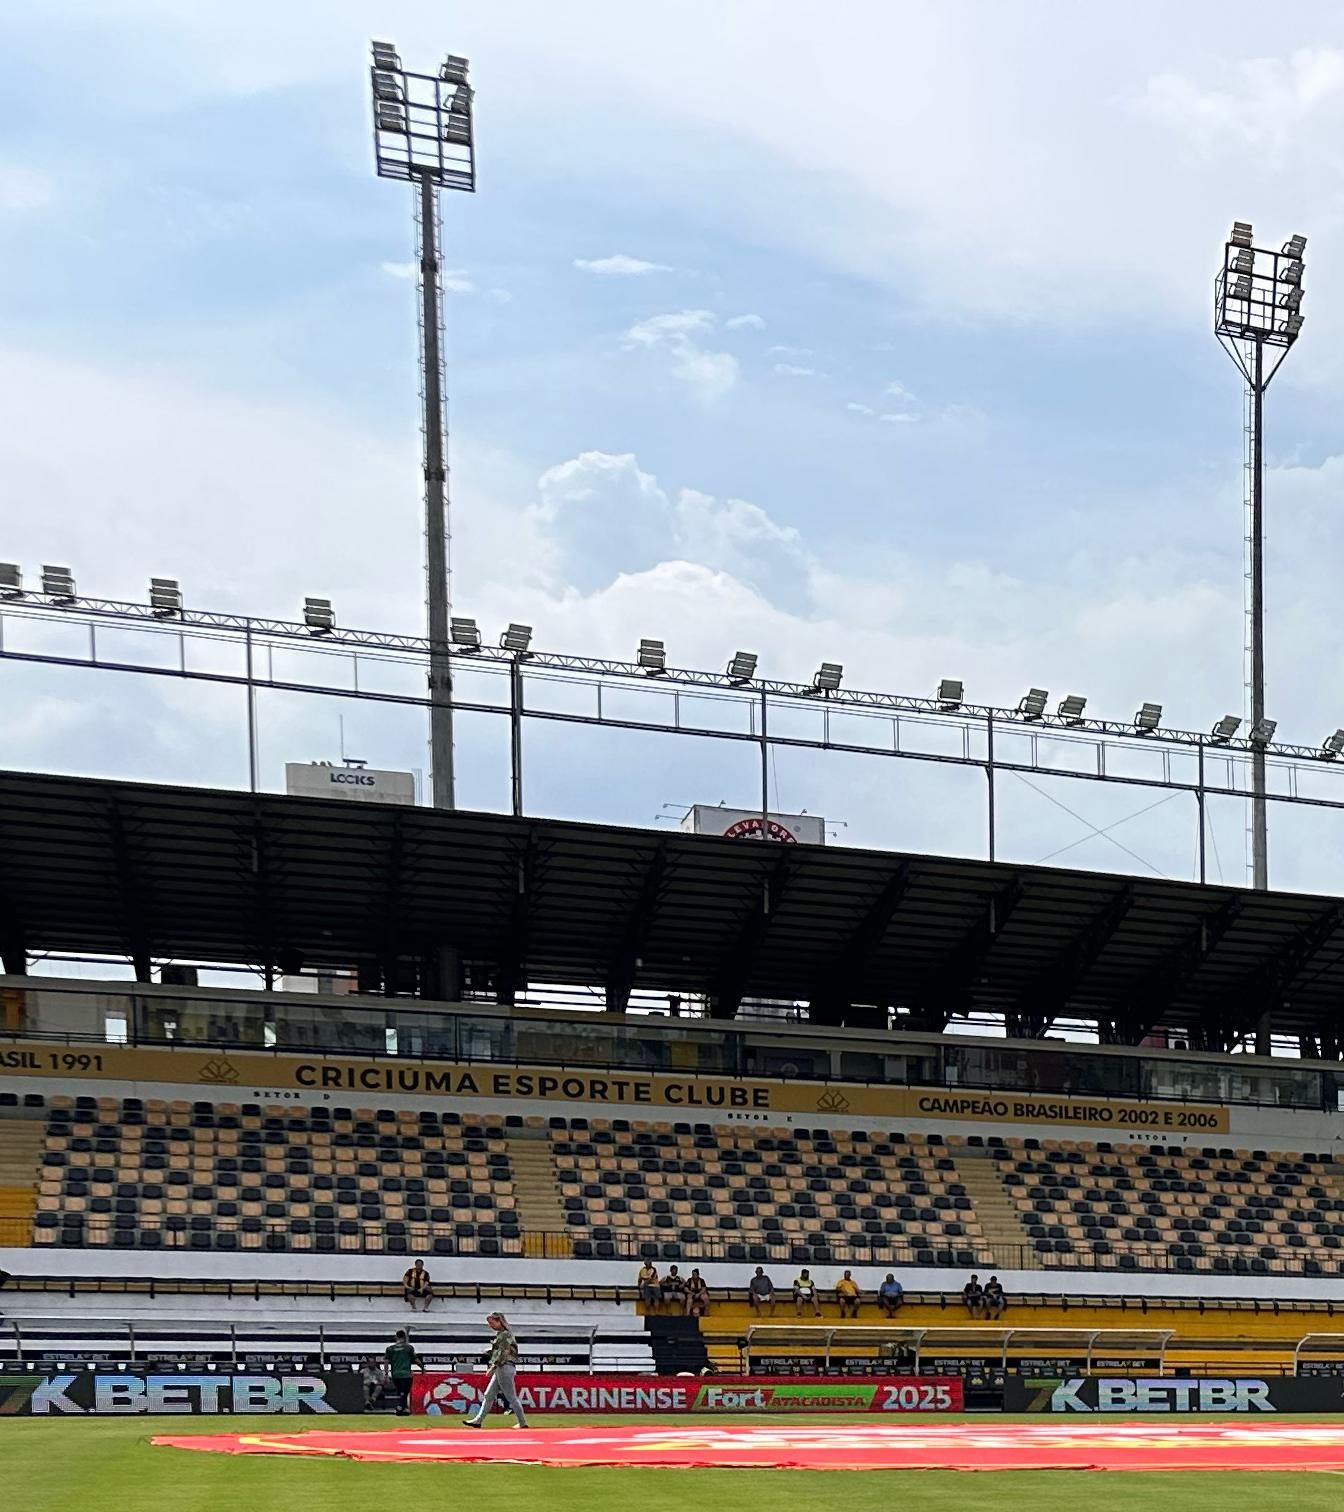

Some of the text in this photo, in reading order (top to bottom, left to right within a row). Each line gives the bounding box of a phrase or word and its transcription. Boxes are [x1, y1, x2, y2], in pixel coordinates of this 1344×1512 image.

[49, 1053, 103, 1071] 1991
[295, 1064, 770, 1108] CRICIÚMA ESPORTE CLUBE
[918, 1097, 1218, 1128] CAMPEÃO BRASILEIRO 2002 E 2006
[517, 1387, 686, 1410] ATARINENSE
[706, 1387, 768, 1408] Fort
[882, 1386, 952, 1410] 2025
